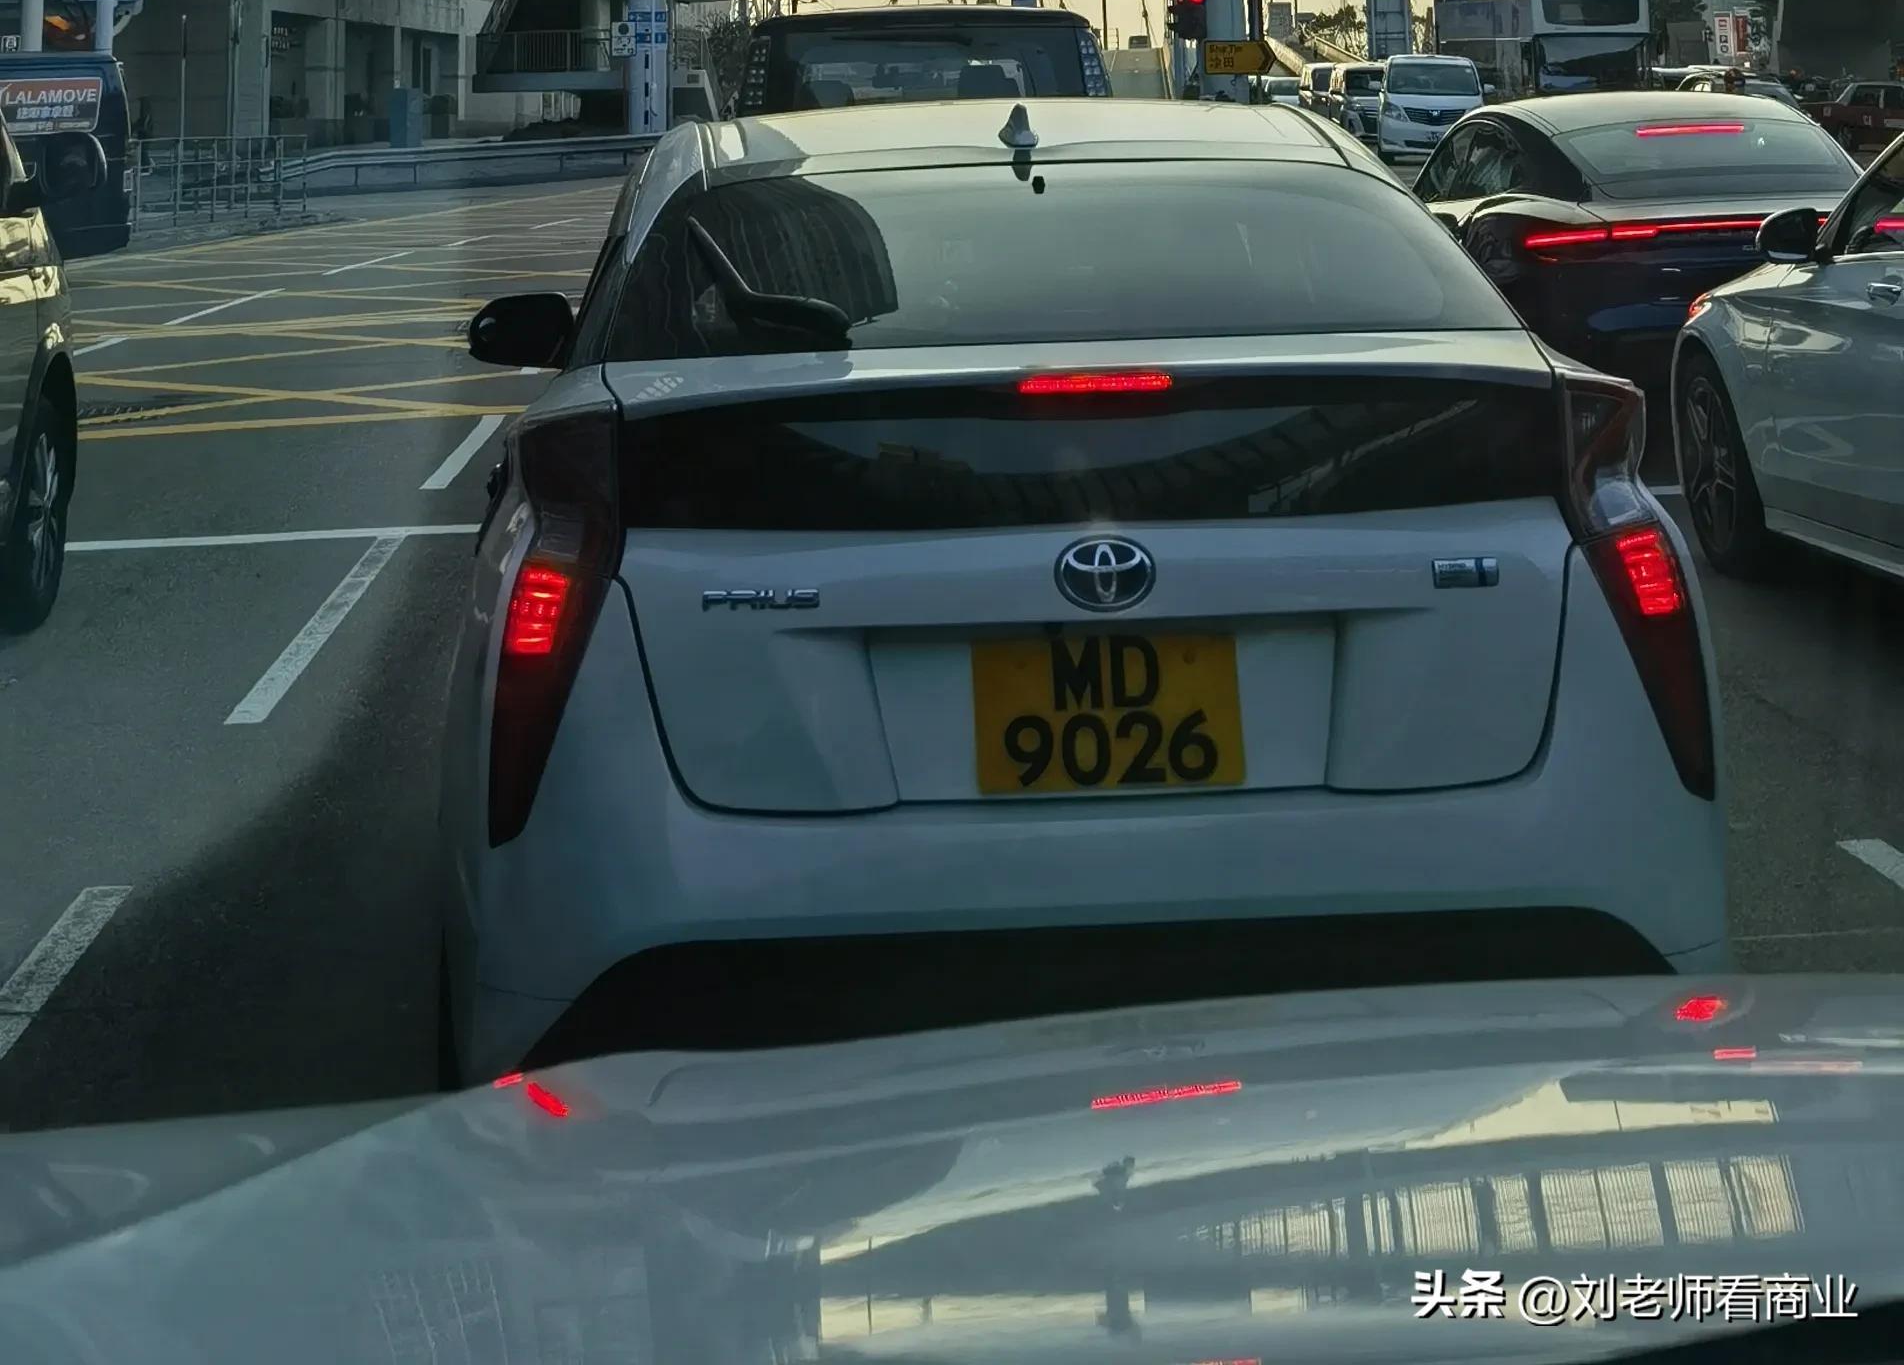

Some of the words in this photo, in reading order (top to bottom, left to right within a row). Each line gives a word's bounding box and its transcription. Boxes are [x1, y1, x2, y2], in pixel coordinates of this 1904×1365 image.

[5, 88, 97, 105] LALAMOVE
[702, 589, 820, 611] PRIUS
[1051, 635, 1160, 711] MD
[1004, 709, 1218, 787] 9026
